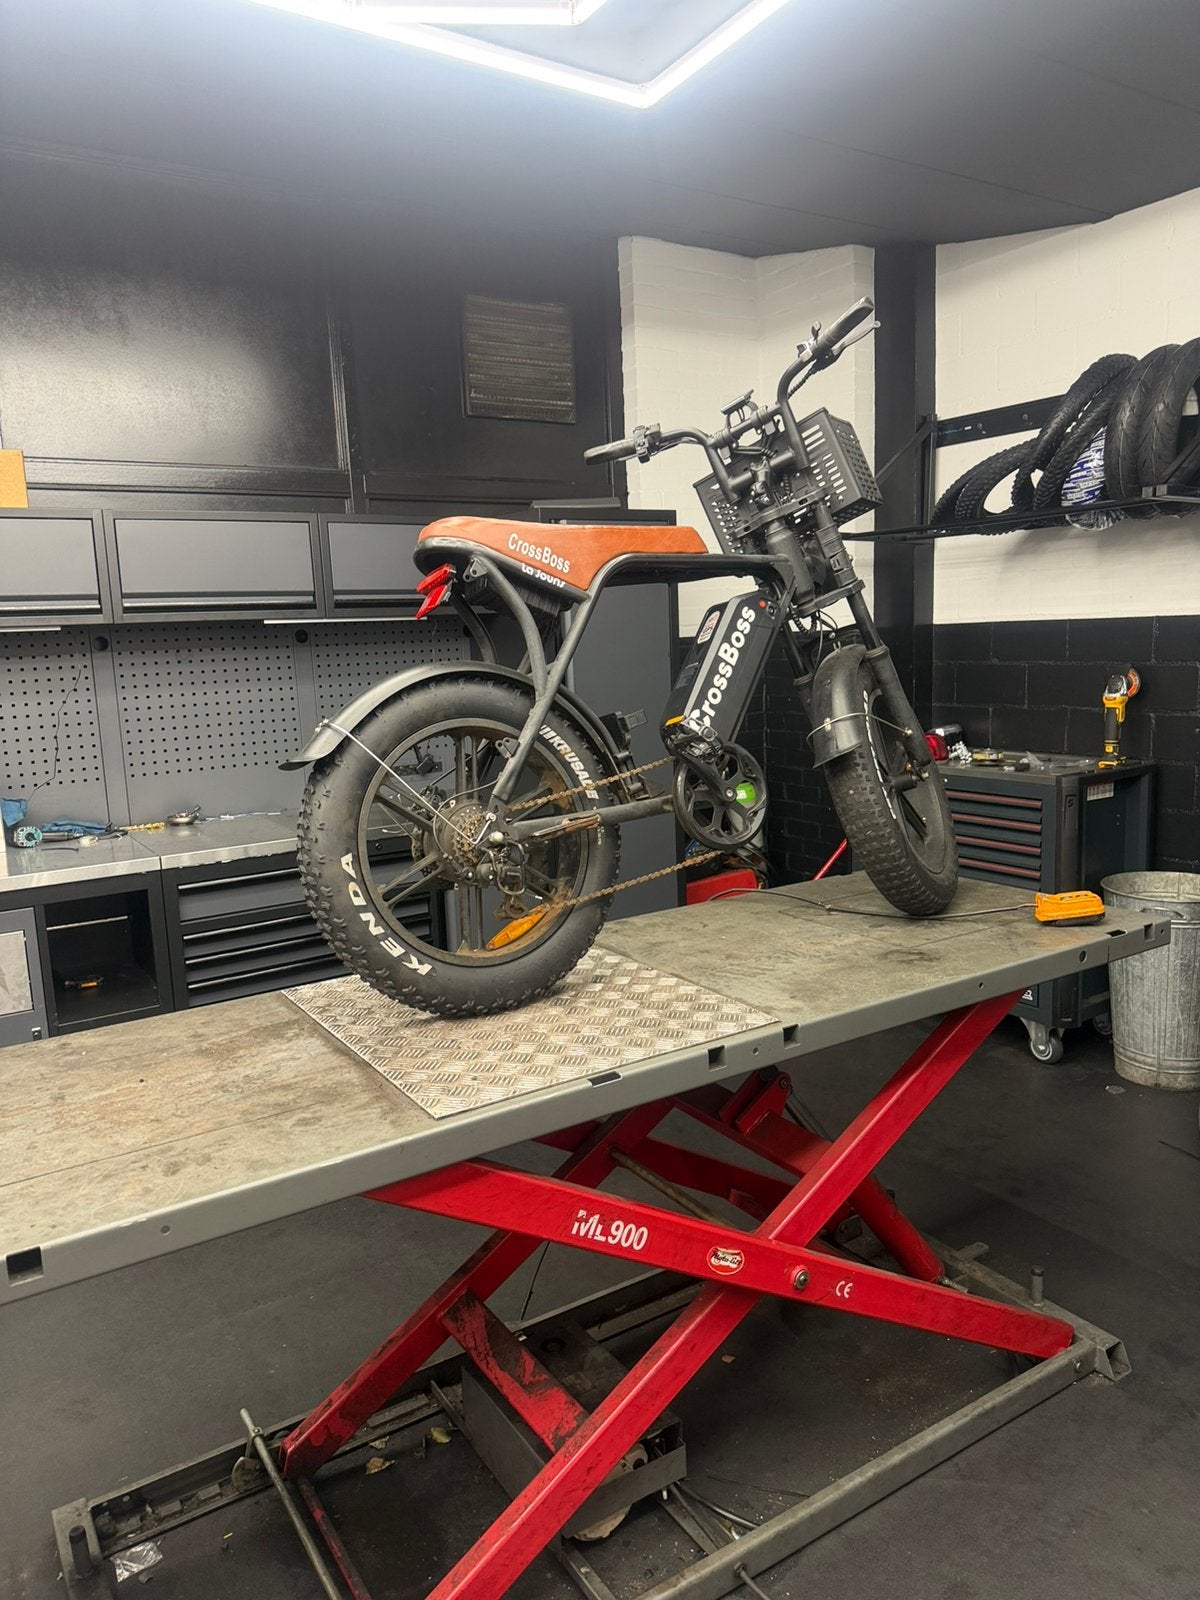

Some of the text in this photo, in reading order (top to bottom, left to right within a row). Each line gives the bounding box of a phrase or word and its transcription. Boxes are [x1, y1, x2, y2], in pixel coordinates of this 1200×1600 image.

[508, 533, 571, 574] CrossBoss
[688, 606, 756, 730] CrossBoss
[340, 852, 433, 976] KENDA
[571, 1209, 649, 1251] ML900
[835, 1280, 853, 1299] CE
